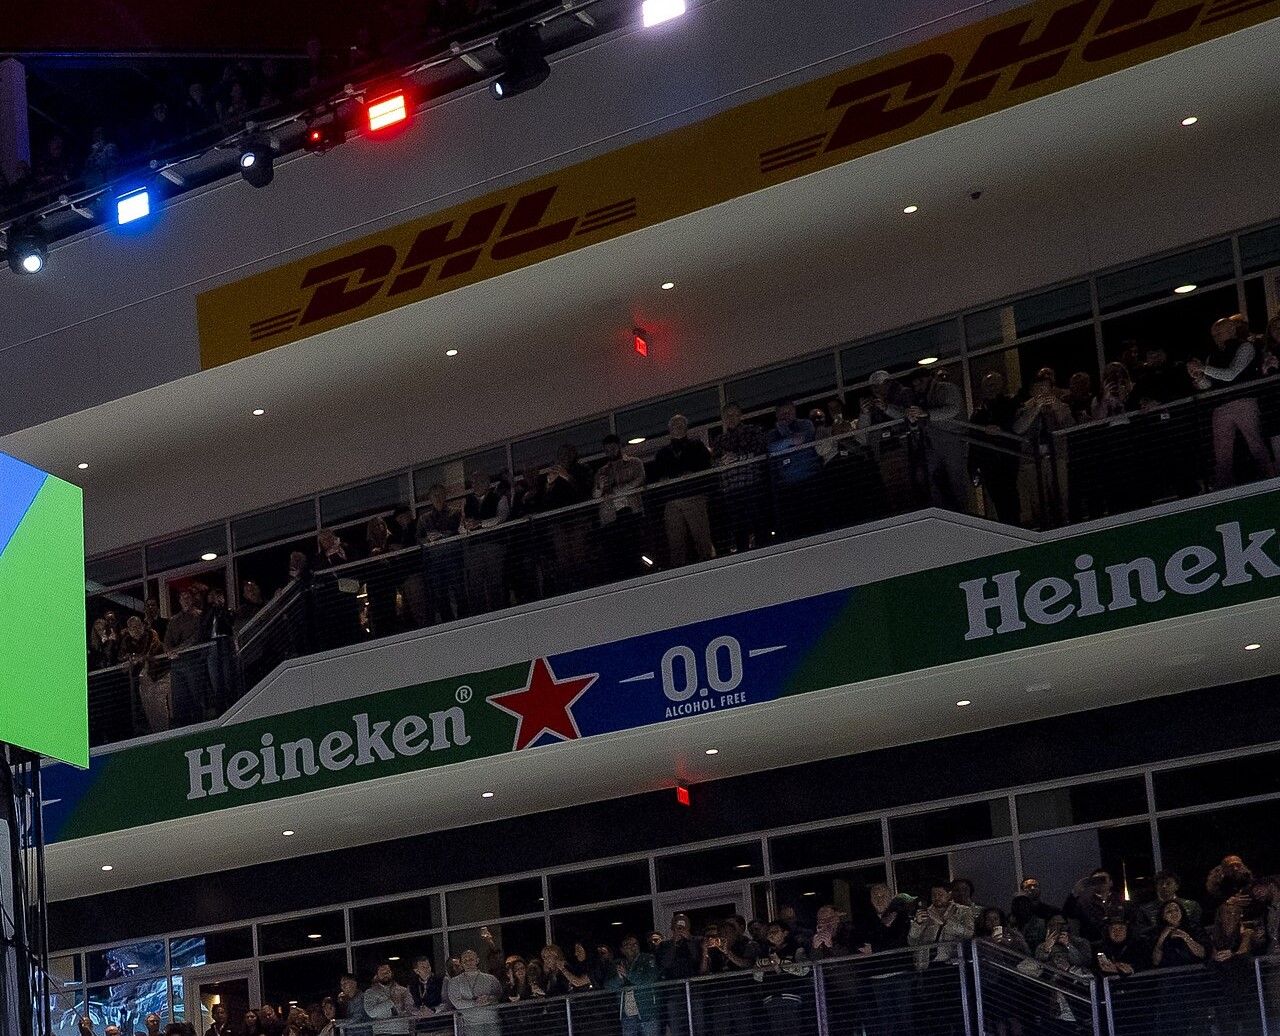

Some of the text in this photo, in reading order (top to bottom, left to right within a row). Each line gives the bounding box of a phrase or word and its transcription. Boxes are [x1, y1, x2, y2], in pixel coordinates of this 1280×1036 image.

[296, 187, 583, 326] DHL
[661, 635, 744, 701] 0.0
[664, 691, 747, 718] ALCOHOL FREE
[185, 702, 471, 800] Heineken
